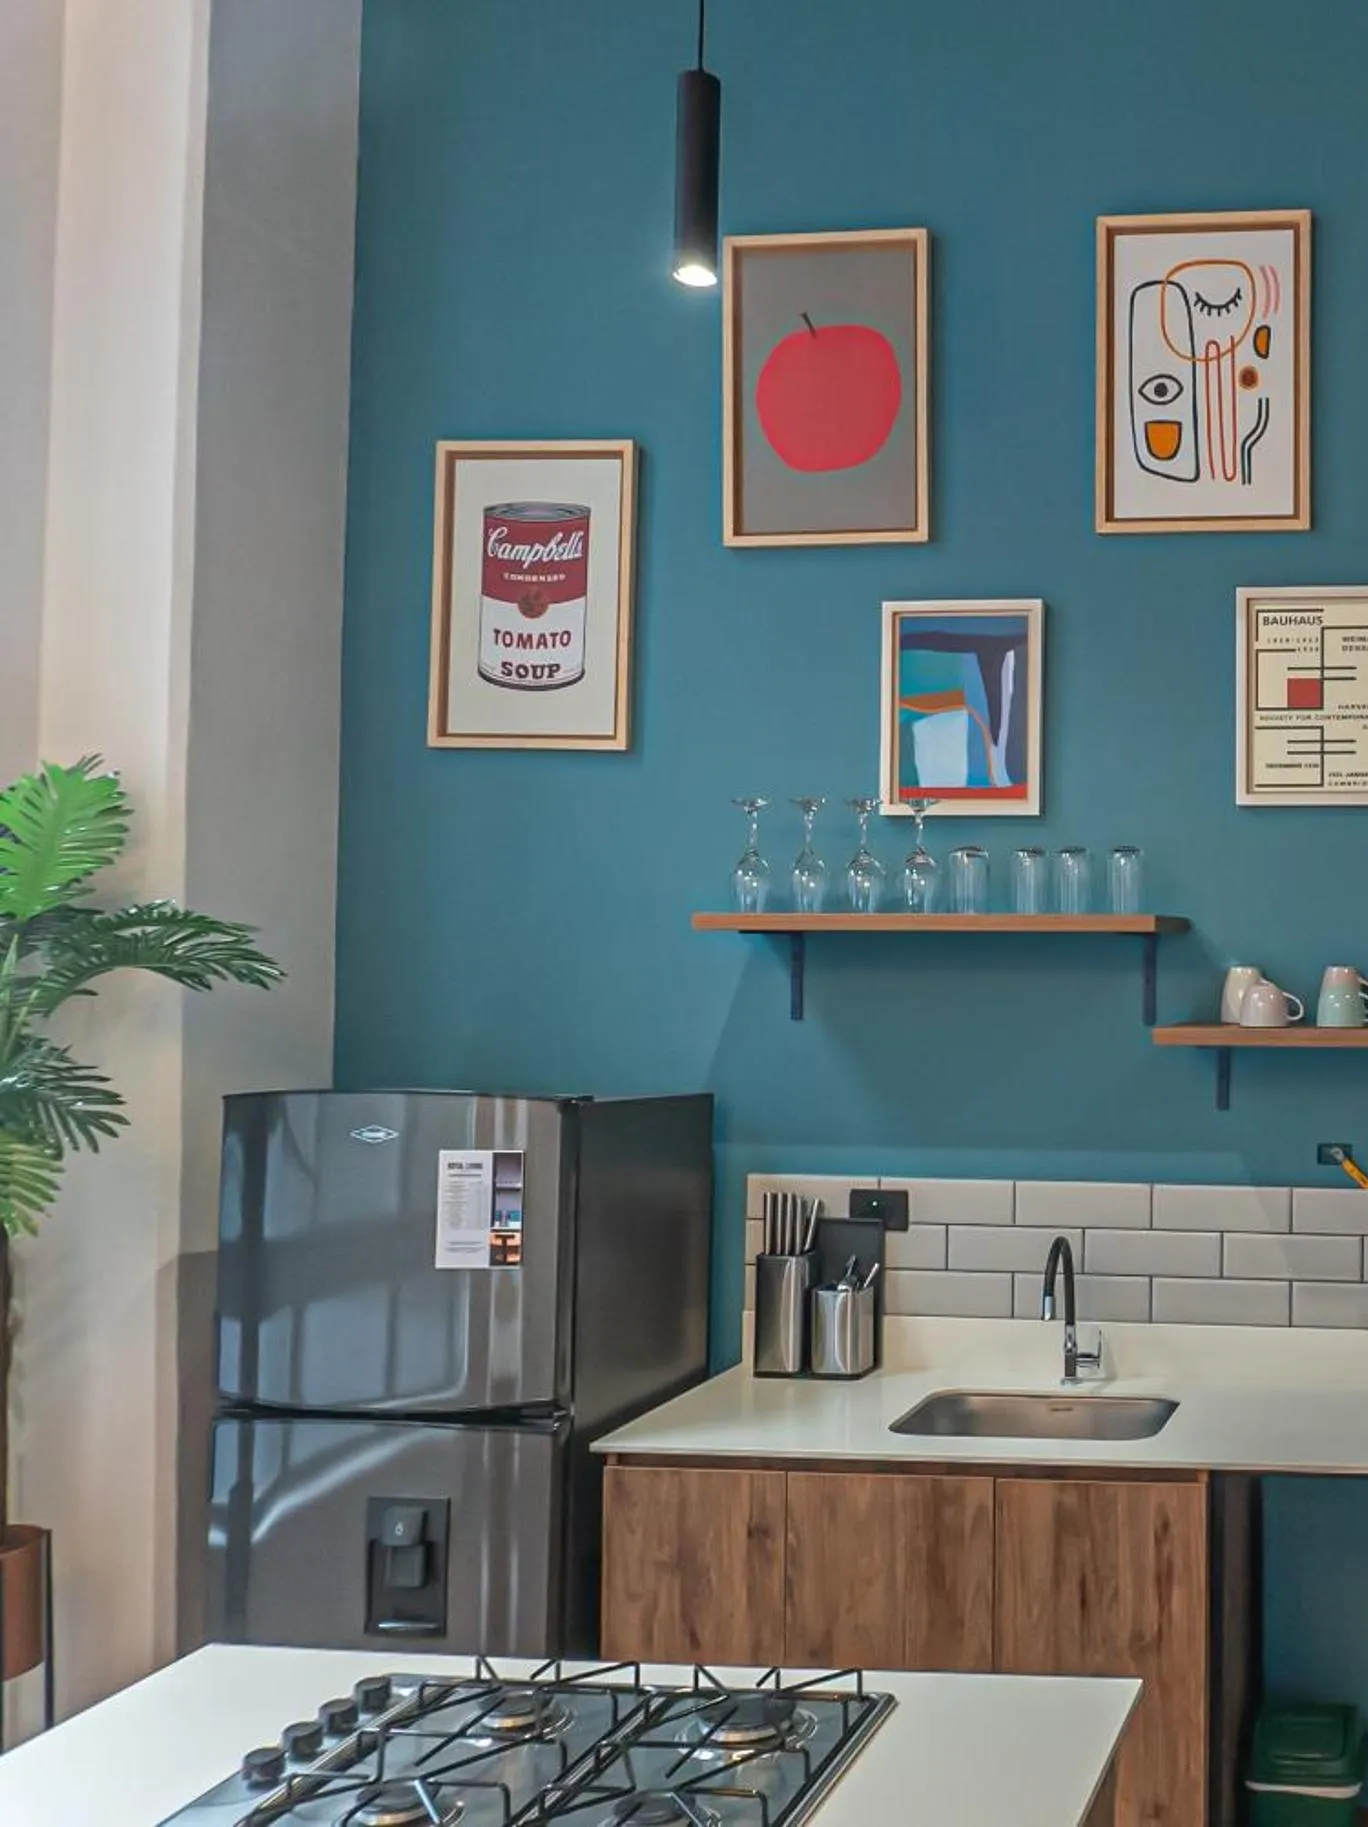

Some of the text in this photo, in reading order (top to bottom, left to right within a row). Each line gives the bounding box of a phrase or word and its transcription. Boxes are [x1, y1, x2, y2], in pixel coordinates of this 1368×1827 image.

[1263, 615, 1323, 626] BAUHAUS
[493, 628, 572, 650] TOMATO
[501, 661, 561, 680] SOUP
